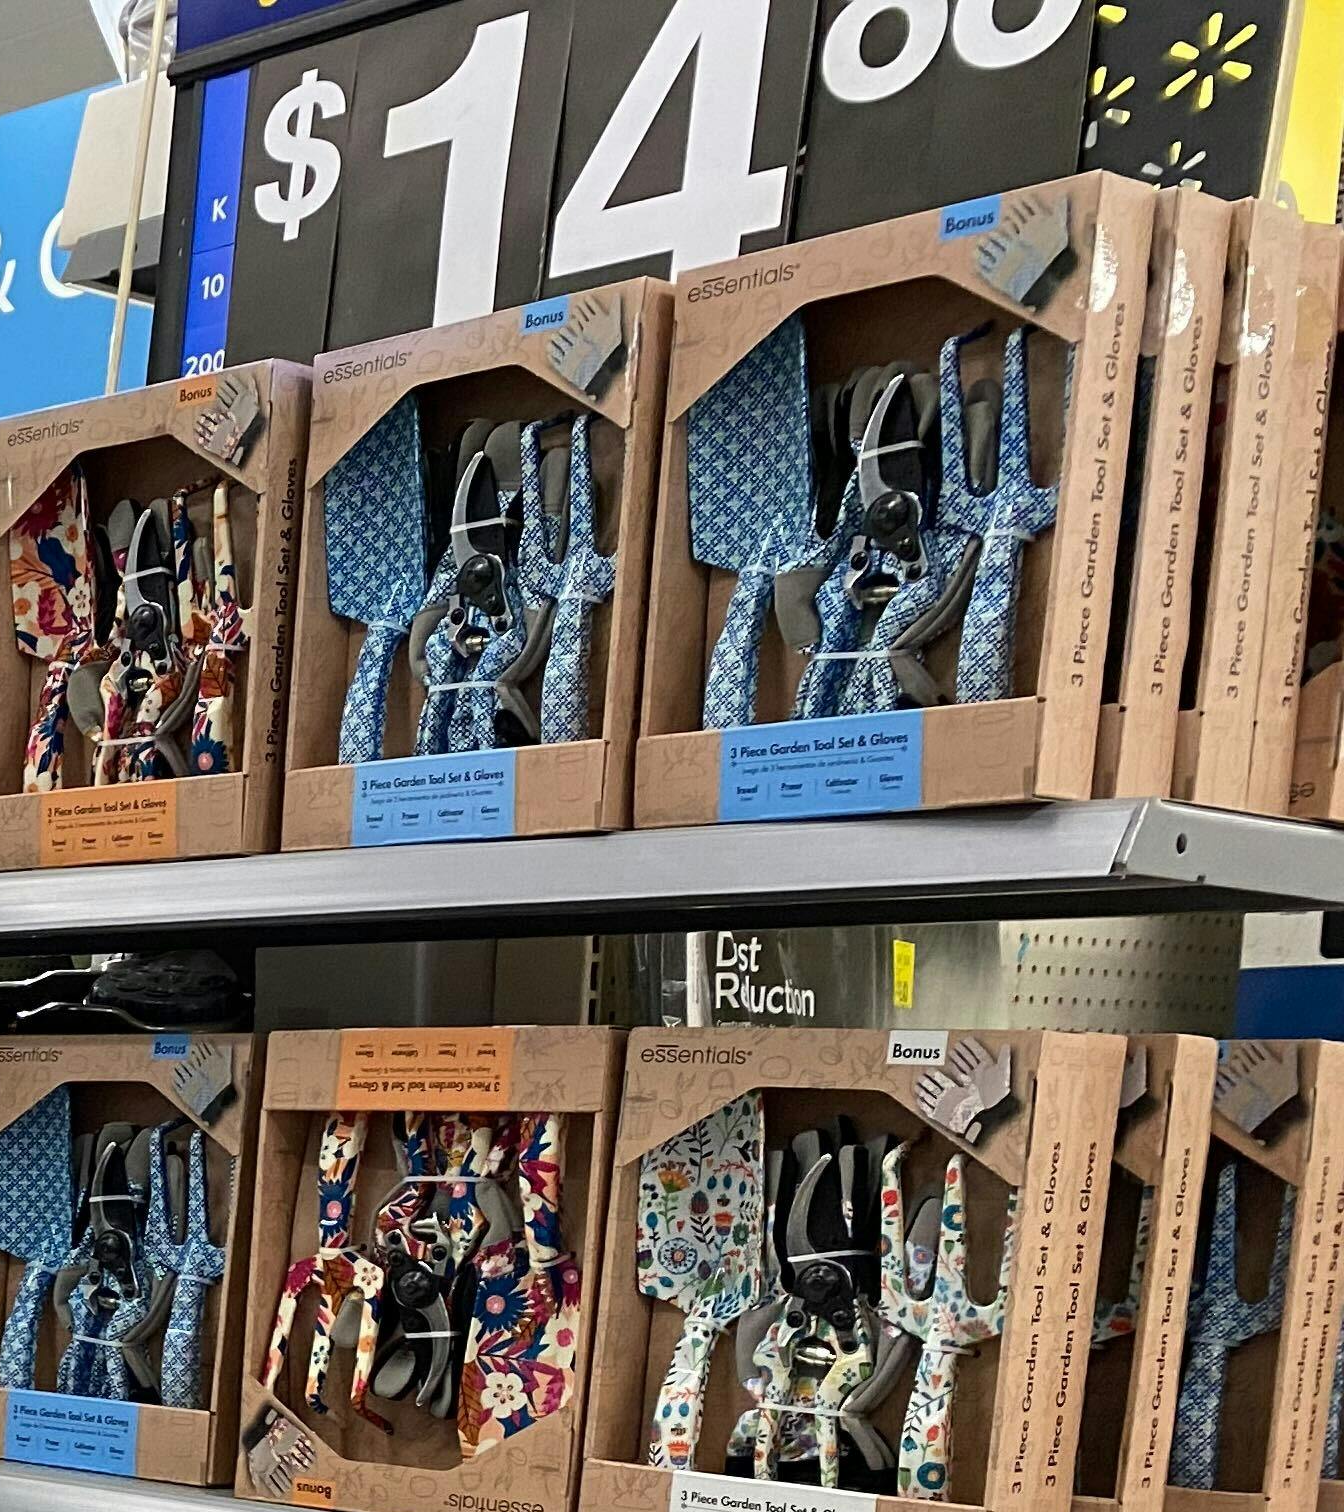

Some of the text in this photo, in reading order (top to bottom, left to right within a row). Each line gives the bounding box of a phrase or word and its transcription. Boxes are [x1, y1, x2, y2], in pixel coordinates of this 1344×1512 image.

[212, 197, 227, 223] K
[944, 211, 995, 234] Bonus
[201, 274, 225, 299] 10
[687, 263, 796, 303] essentials
[525, 309, 564, 327] Bonus
[185, 349, 226, 377] 200
[324, 352, 408, 384] essentials
[179, 384, 212, 402] Bonus
[8, 421, 80, 447] essentials
[1072, 301, 1127, 687] 3 Piece Garden Tool Set & Gloves
[730, 732, 908, 759] 3 Piece Garden Tool Set & Gloves
[154, 1042, 188, 1057] Bonus
[640, 1044, 748, 1066] essentials
[891, 1043, 941, 1061] Bonus
[296, 1480, 332, 1497] Bonus
[681, 1490, 688, 1501] 3
[691, 1491, 718, 1506] Piece
[721, 1495, 761, 1512] Garden
